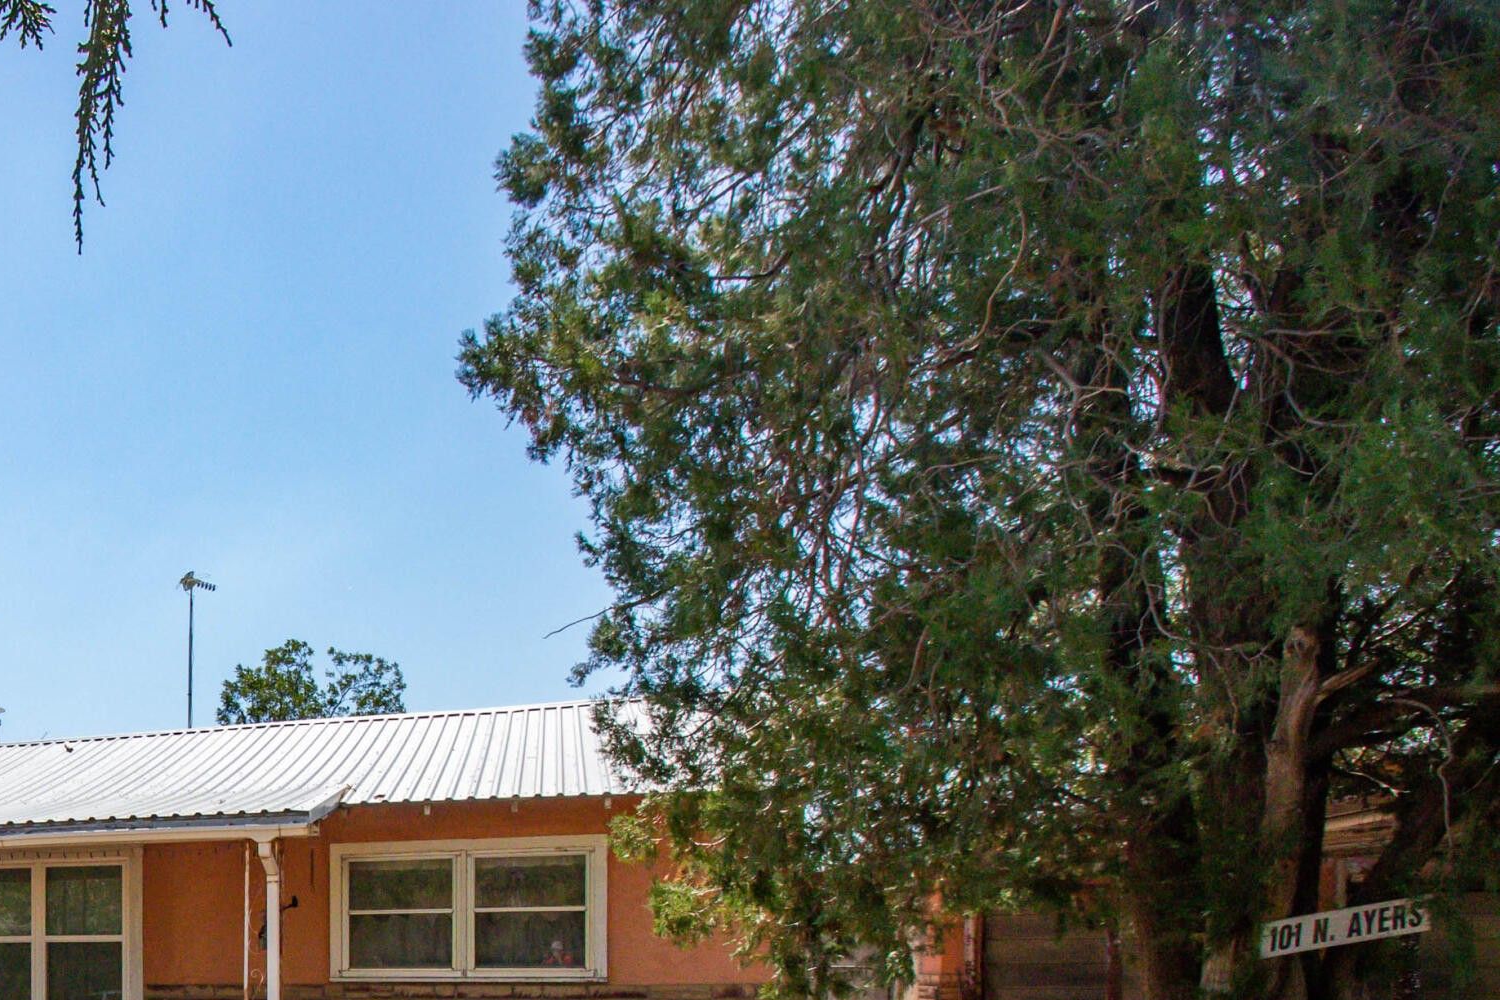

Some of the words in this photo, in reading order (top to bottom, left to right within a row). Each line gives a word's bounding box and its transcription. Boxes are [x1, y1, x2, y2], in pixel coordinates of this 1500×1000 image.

[1269, 922, 1303, 952] 101
[1312, 917, 1335, 944] N.
[1346, 904, 1423, 938] AYERS
